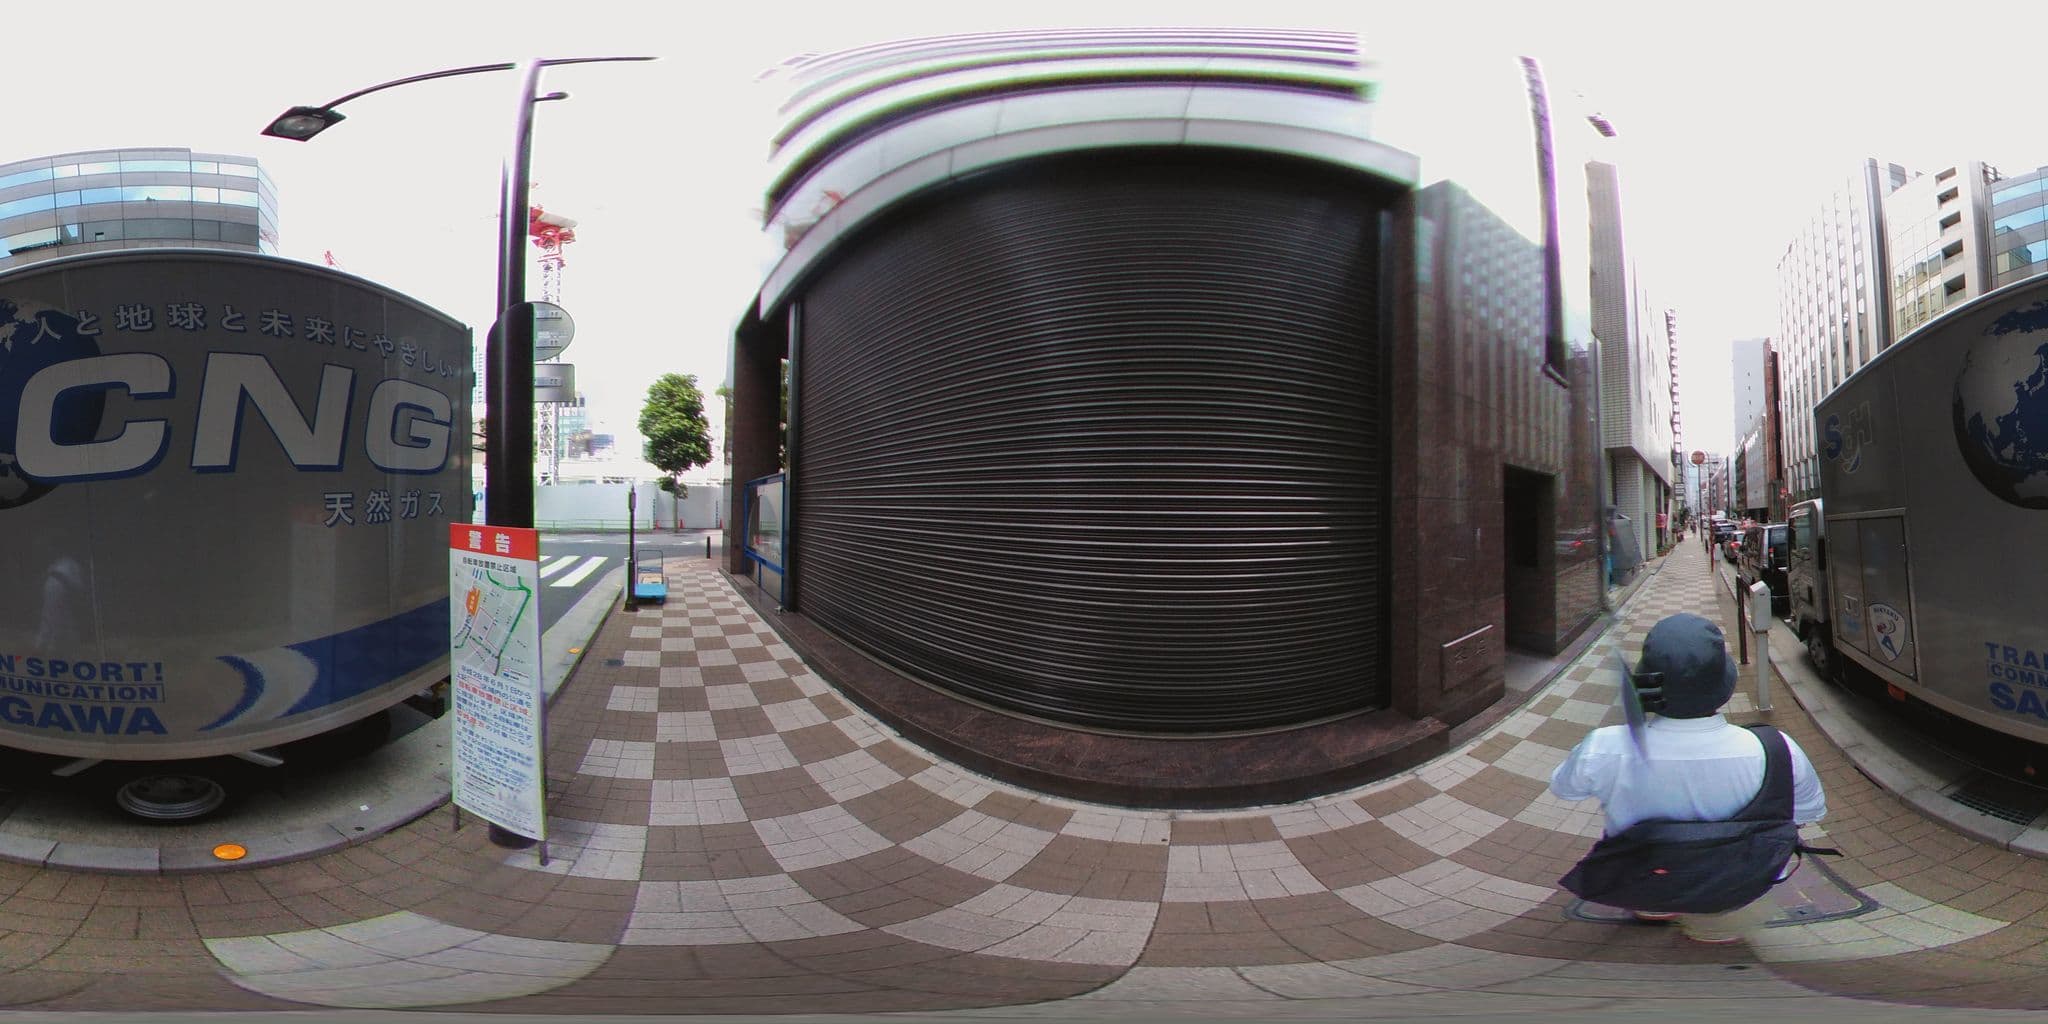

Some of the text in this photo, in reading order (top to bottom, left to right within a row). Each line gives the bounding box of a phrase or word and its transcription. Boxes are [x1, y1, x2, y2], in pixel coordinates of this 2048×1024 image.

[31, 303, 454, 378] 人と地球と未来にやさしい
[15, 351, 453, 484] CNG
[324, 490, 445, 528] 天然ガス
[468, 530, 511, 554] 警告
[1984, 641, 2048, 670] TRA
[1990, 682, 2048, 719] SA
